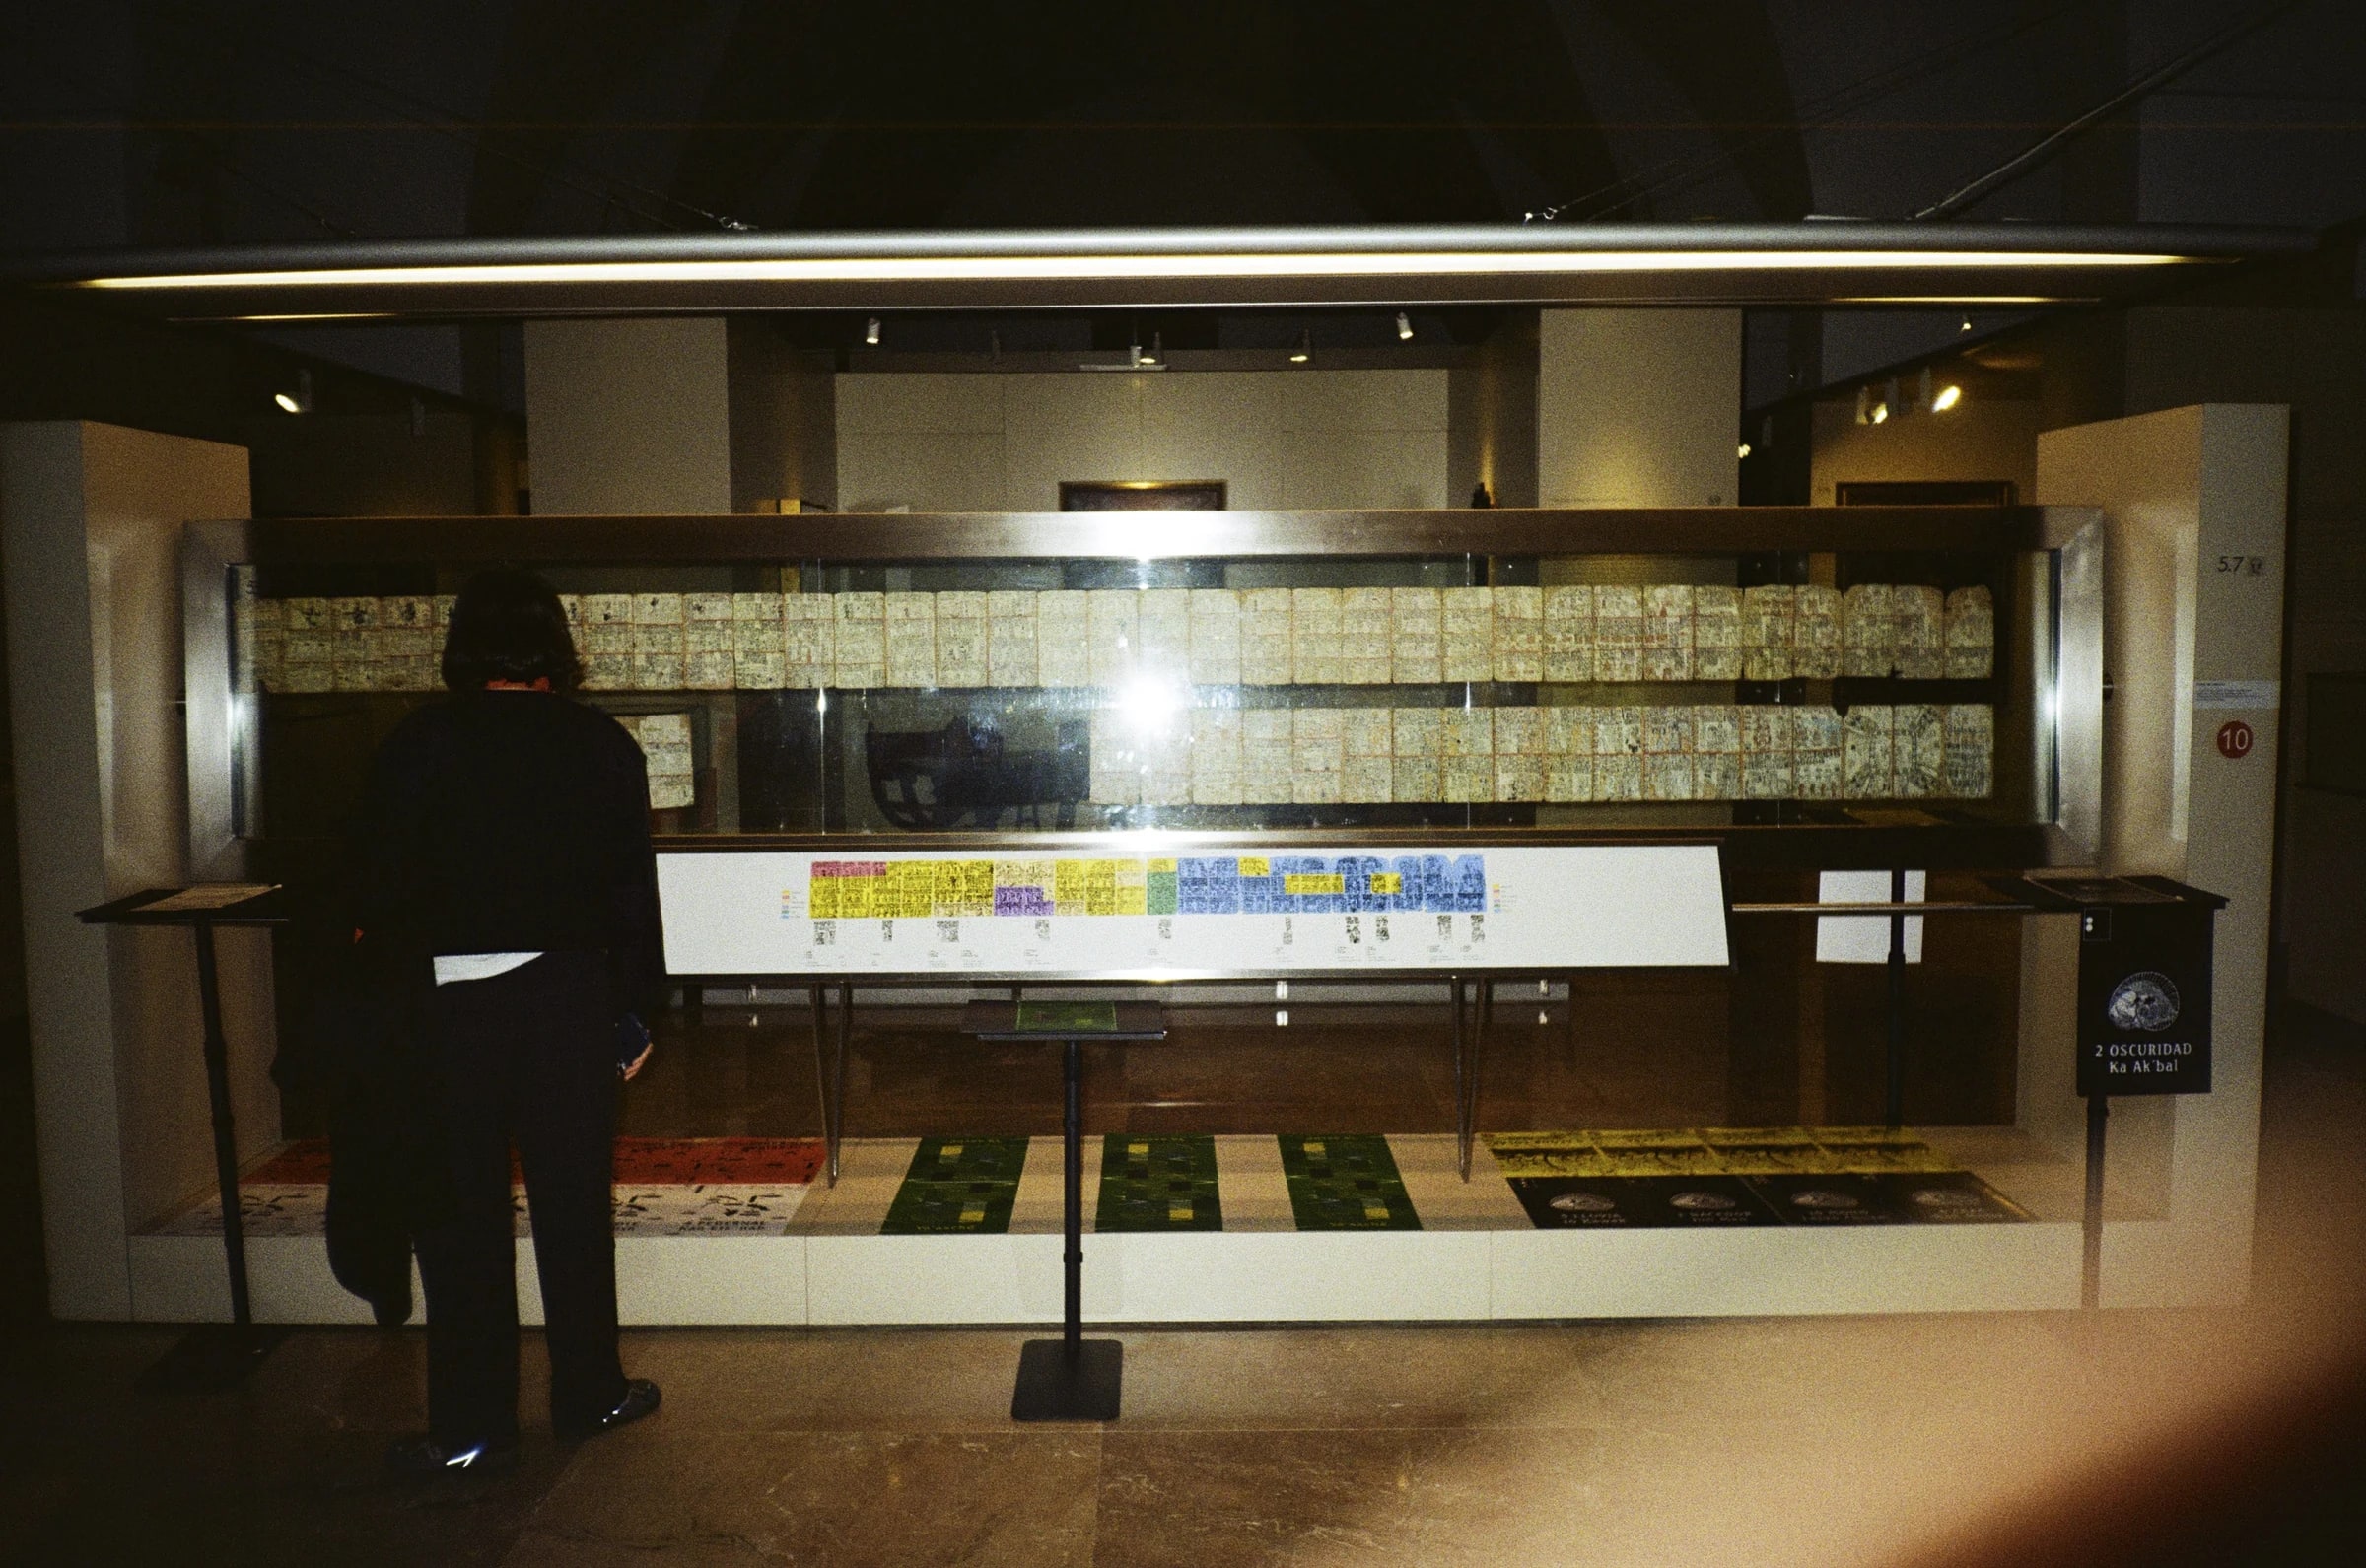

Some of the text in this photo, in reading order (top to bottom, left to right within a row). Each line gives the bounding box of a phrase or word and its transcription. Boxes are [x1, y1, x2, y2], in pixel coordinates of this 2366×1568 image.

[2217, 556, 2244, 572] 5.7
[2222, 728, 2249, 750] 10
[2095, 1043, 2192, 1057] 2 OSCURIDAD
[2110, 1061, 2127, 1073] Ka
